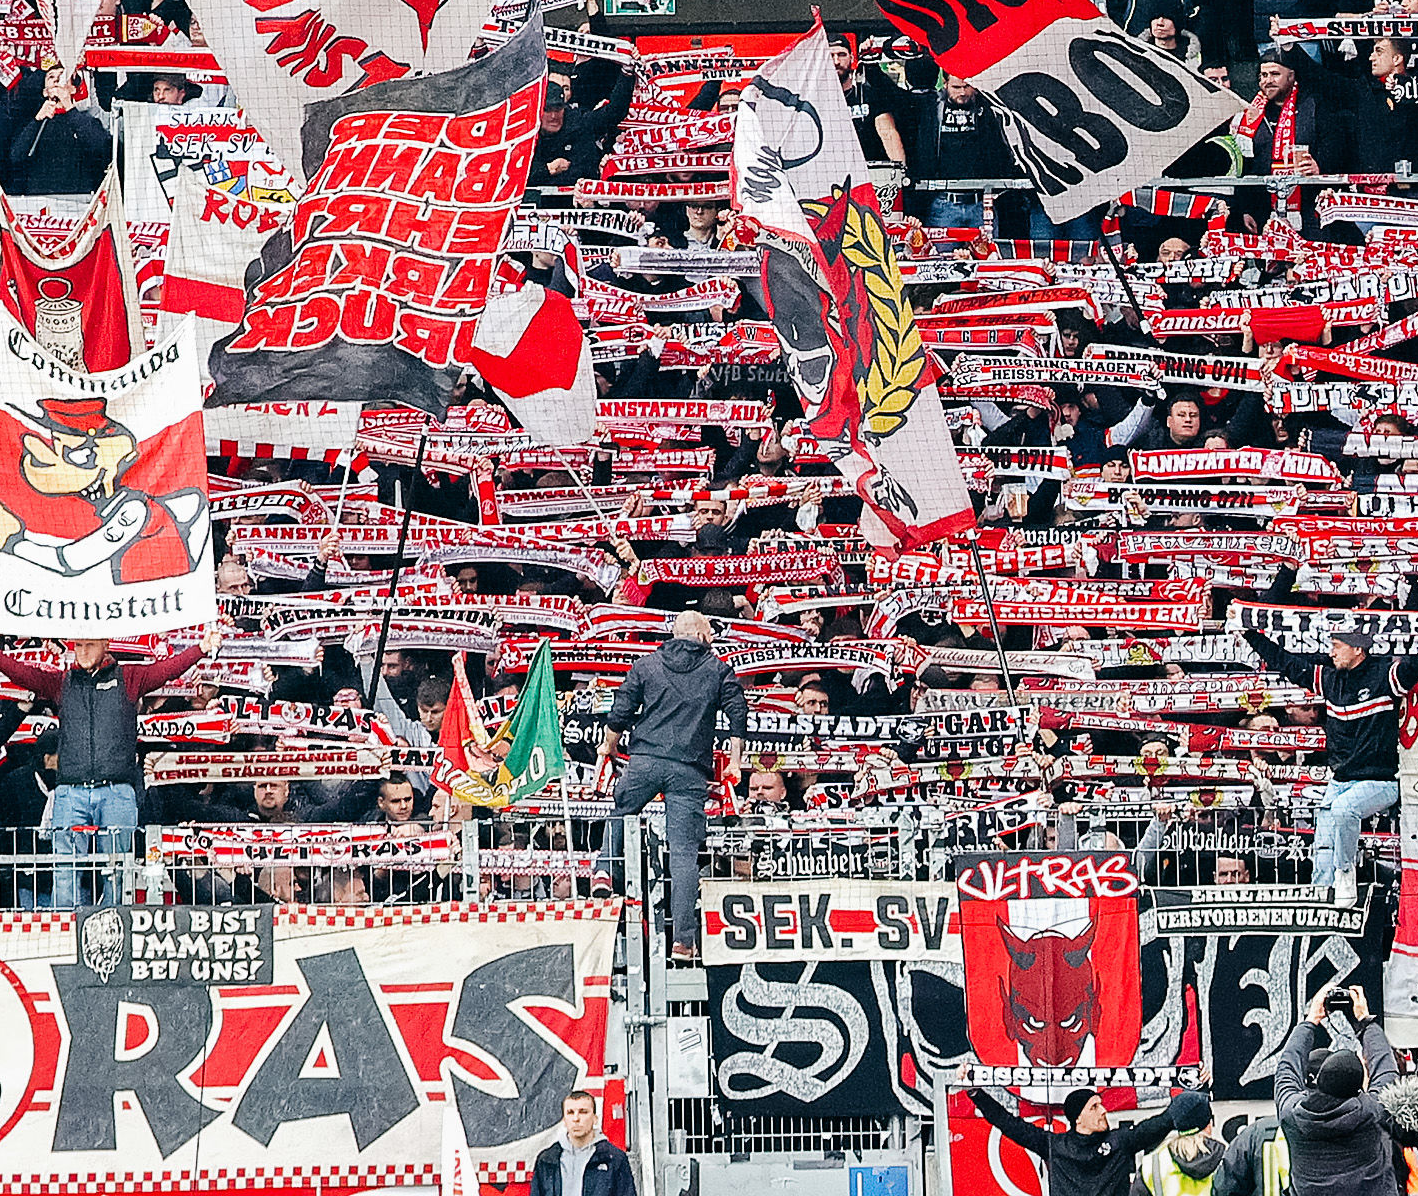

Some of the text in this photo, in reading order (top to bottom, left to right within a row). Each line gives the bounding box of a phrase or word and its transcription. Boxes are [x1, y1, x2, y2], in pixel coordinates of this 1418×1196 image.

[583, 180, 717, 198] CANNSTATTER
[8, 327, 181, 398] Commando
[236, 526, 390, 542] CANNSTATTER
[3, 586, 185, 620] Cannstatt
[958, 853, 1141, 902] ULTRAS
[131, 909, 263, 936] DU BIST
[723, 893, 949, 952] SEK. SV
[1157, 909, 1364, 931] VERSTORBENEN ULTRAS
[131, 933, 260, 960] IMMER
[131, 958, 266, 983] BEI UNS!
